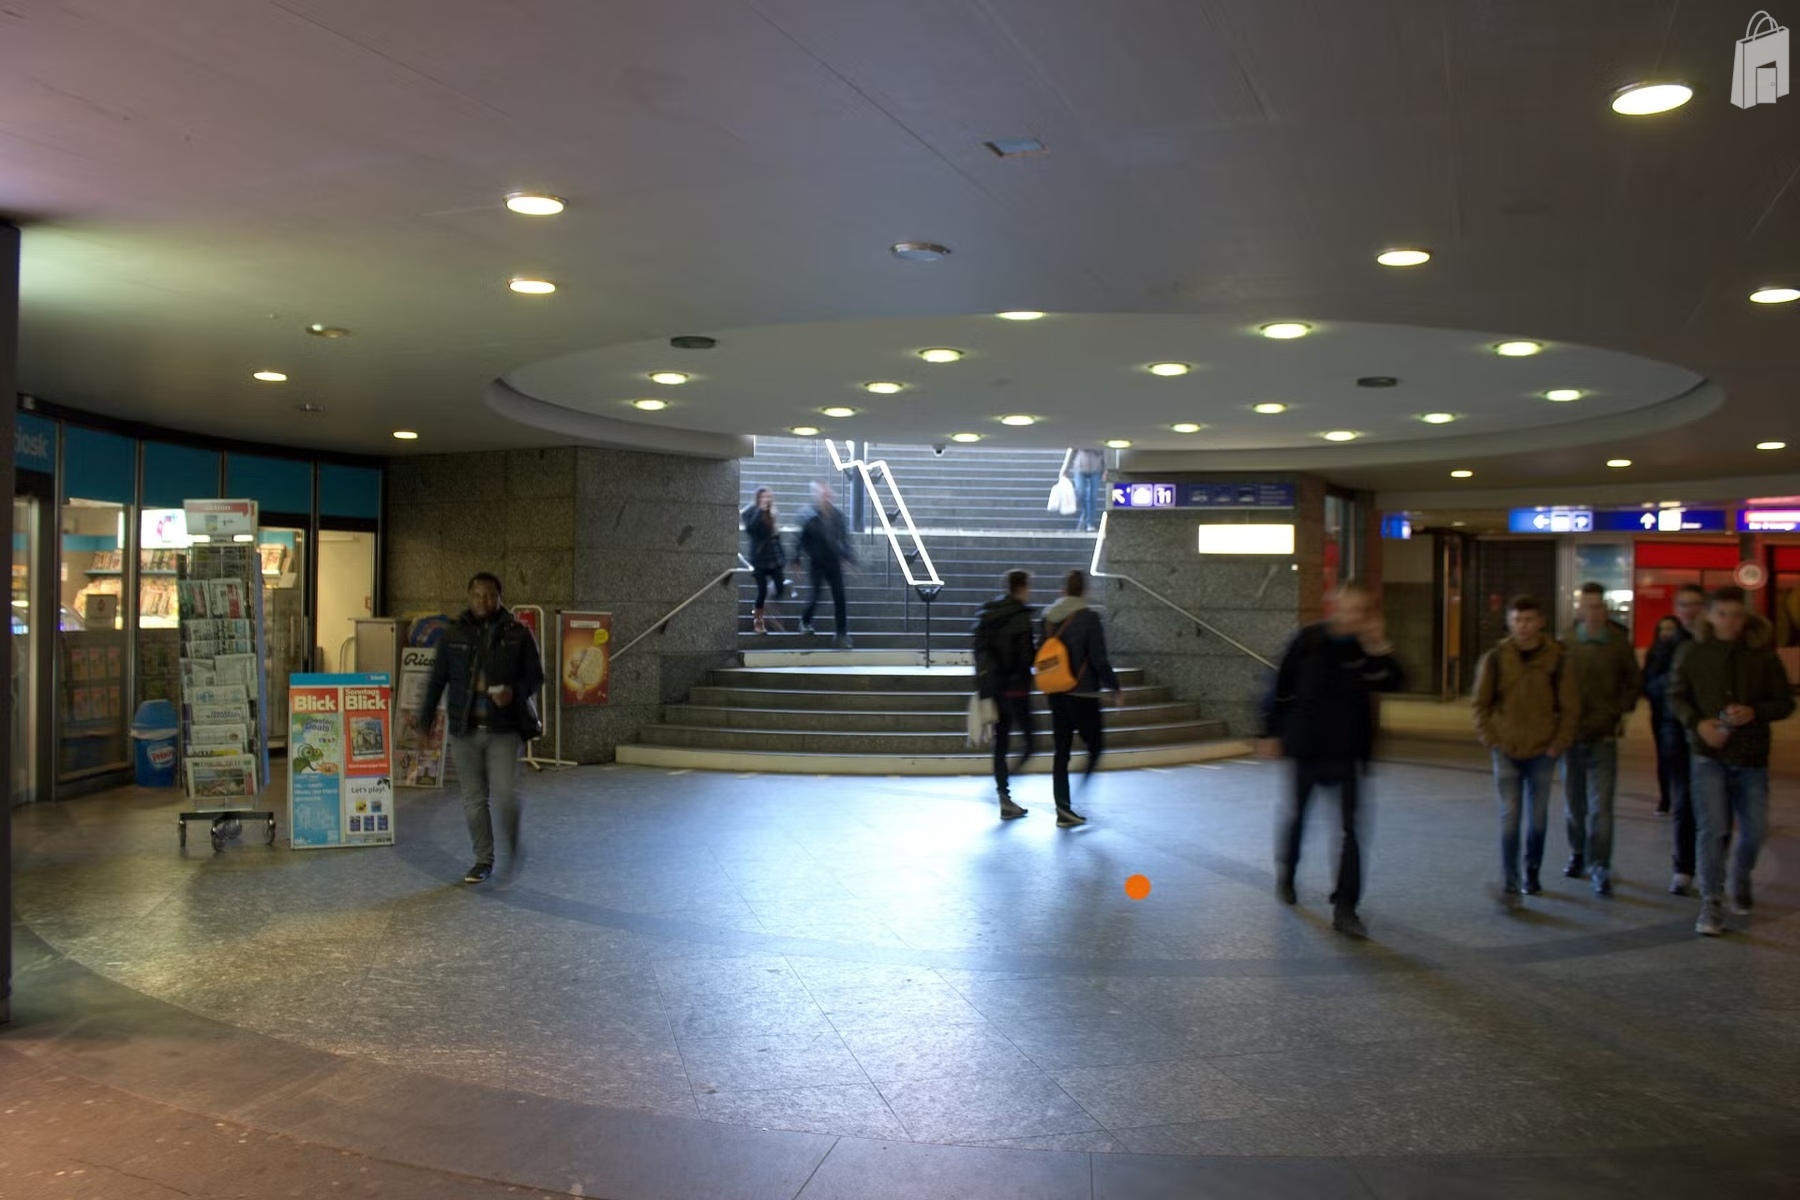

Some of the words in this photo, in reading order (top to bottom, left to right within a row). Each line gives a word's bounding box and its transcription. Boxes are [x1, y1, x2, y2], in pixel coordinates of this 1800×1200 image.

[15, 425, 48, 459] iosk
[345, 689, 380, 698] Sonntags
[294, 695, 337, 711] Blick
[345, 695, 387, 711] Blick
[351, 786, 368, 794] Let's
[368, 785, 386, 795] play!
